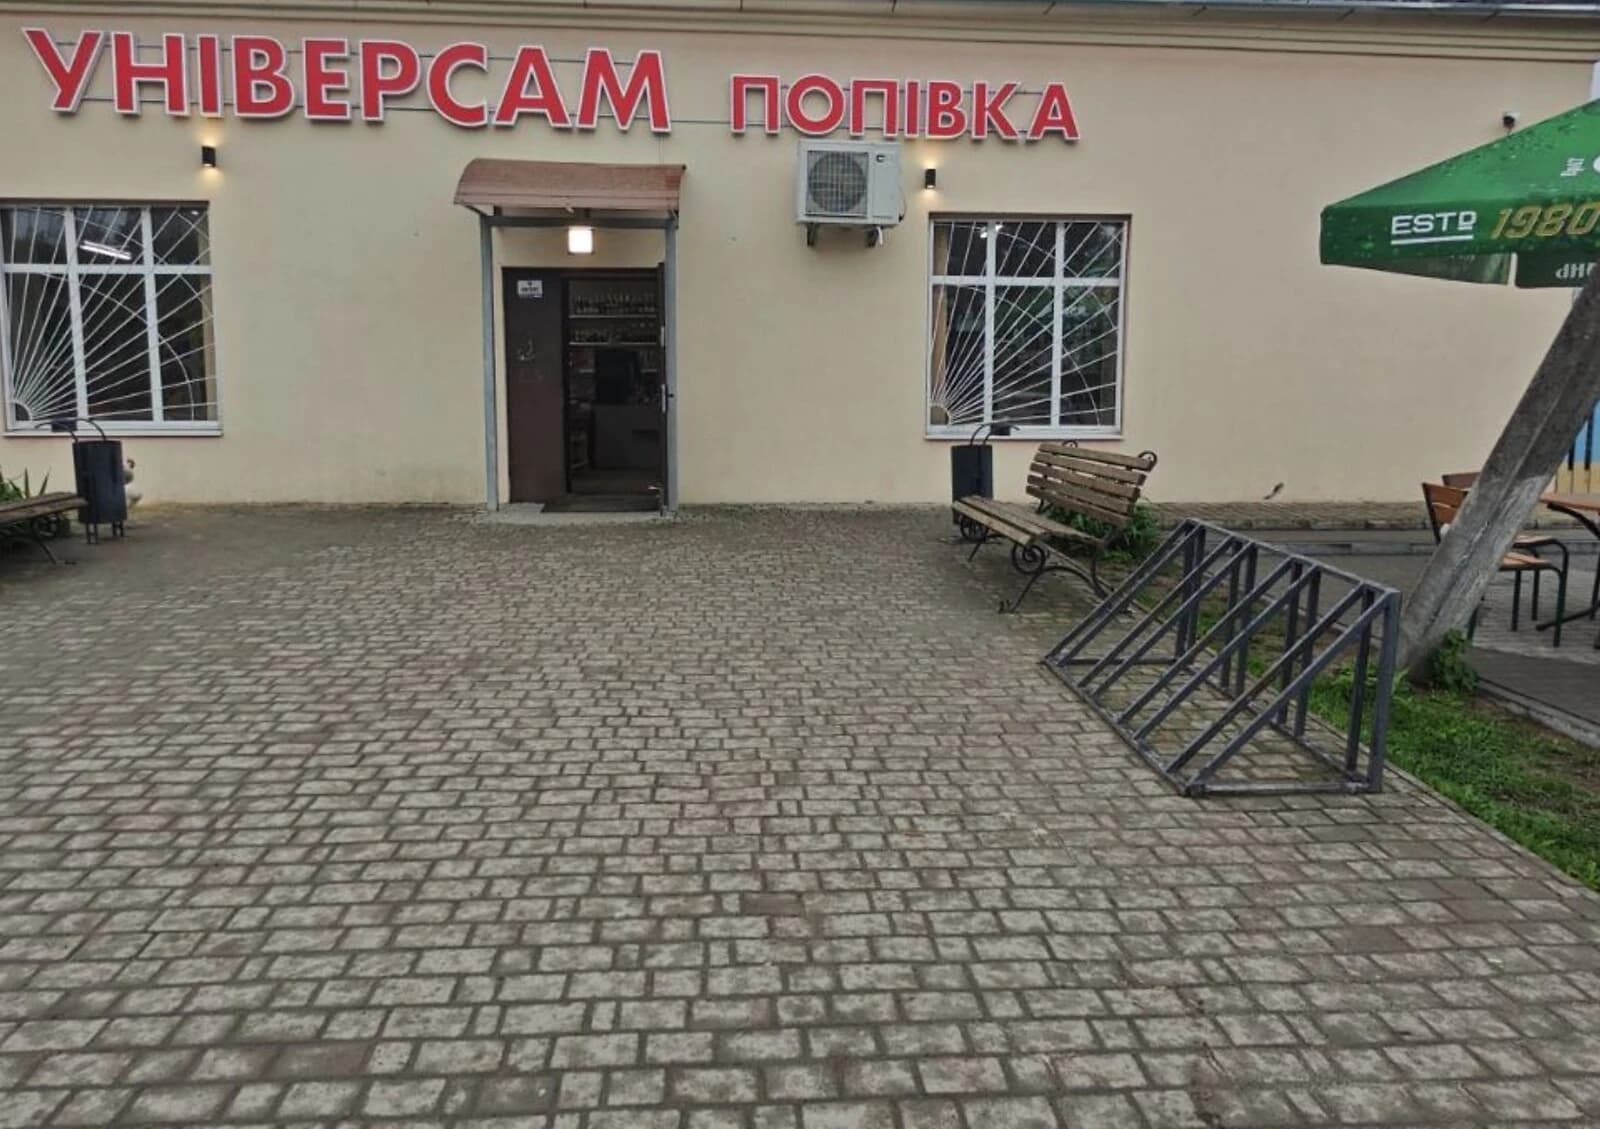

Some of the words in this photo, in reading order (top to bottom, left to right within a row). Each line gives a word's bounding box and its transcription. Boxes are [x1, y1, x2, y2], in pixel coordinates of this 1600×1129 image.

[22, 27, 671, 134] УНІВЕРСАМ
[730, 73, 1081, 141] ПОПІВКА
[1391, 210, 1477, 235] ESTD
[1491, 201, 1600, 240] 1980
